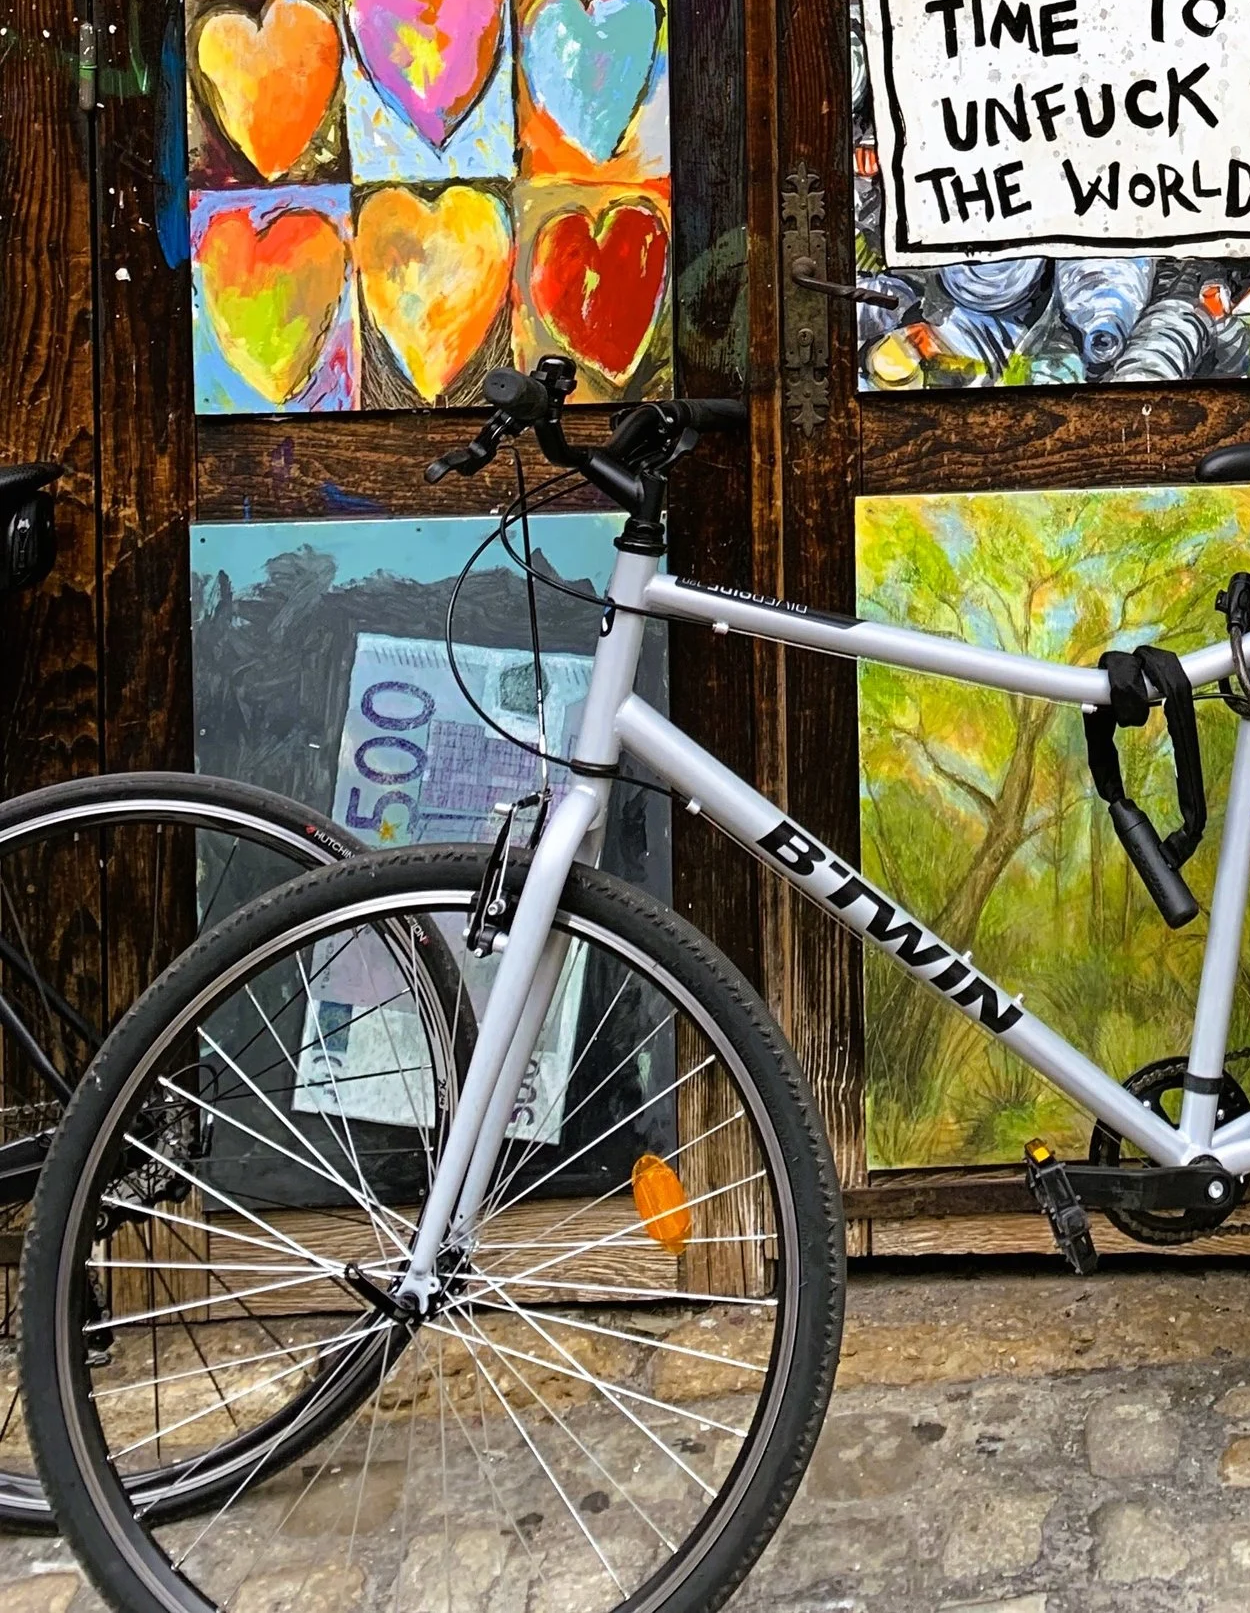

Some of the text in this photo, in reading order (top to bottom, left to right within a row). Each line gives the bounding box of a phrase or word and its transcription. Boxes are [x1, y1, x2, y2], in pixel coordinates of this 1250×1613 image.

[941, 62, 1220, 152] UNFUCK
[914, 160, 1033, 224] THE
[345, 680, 436, 836] 500
